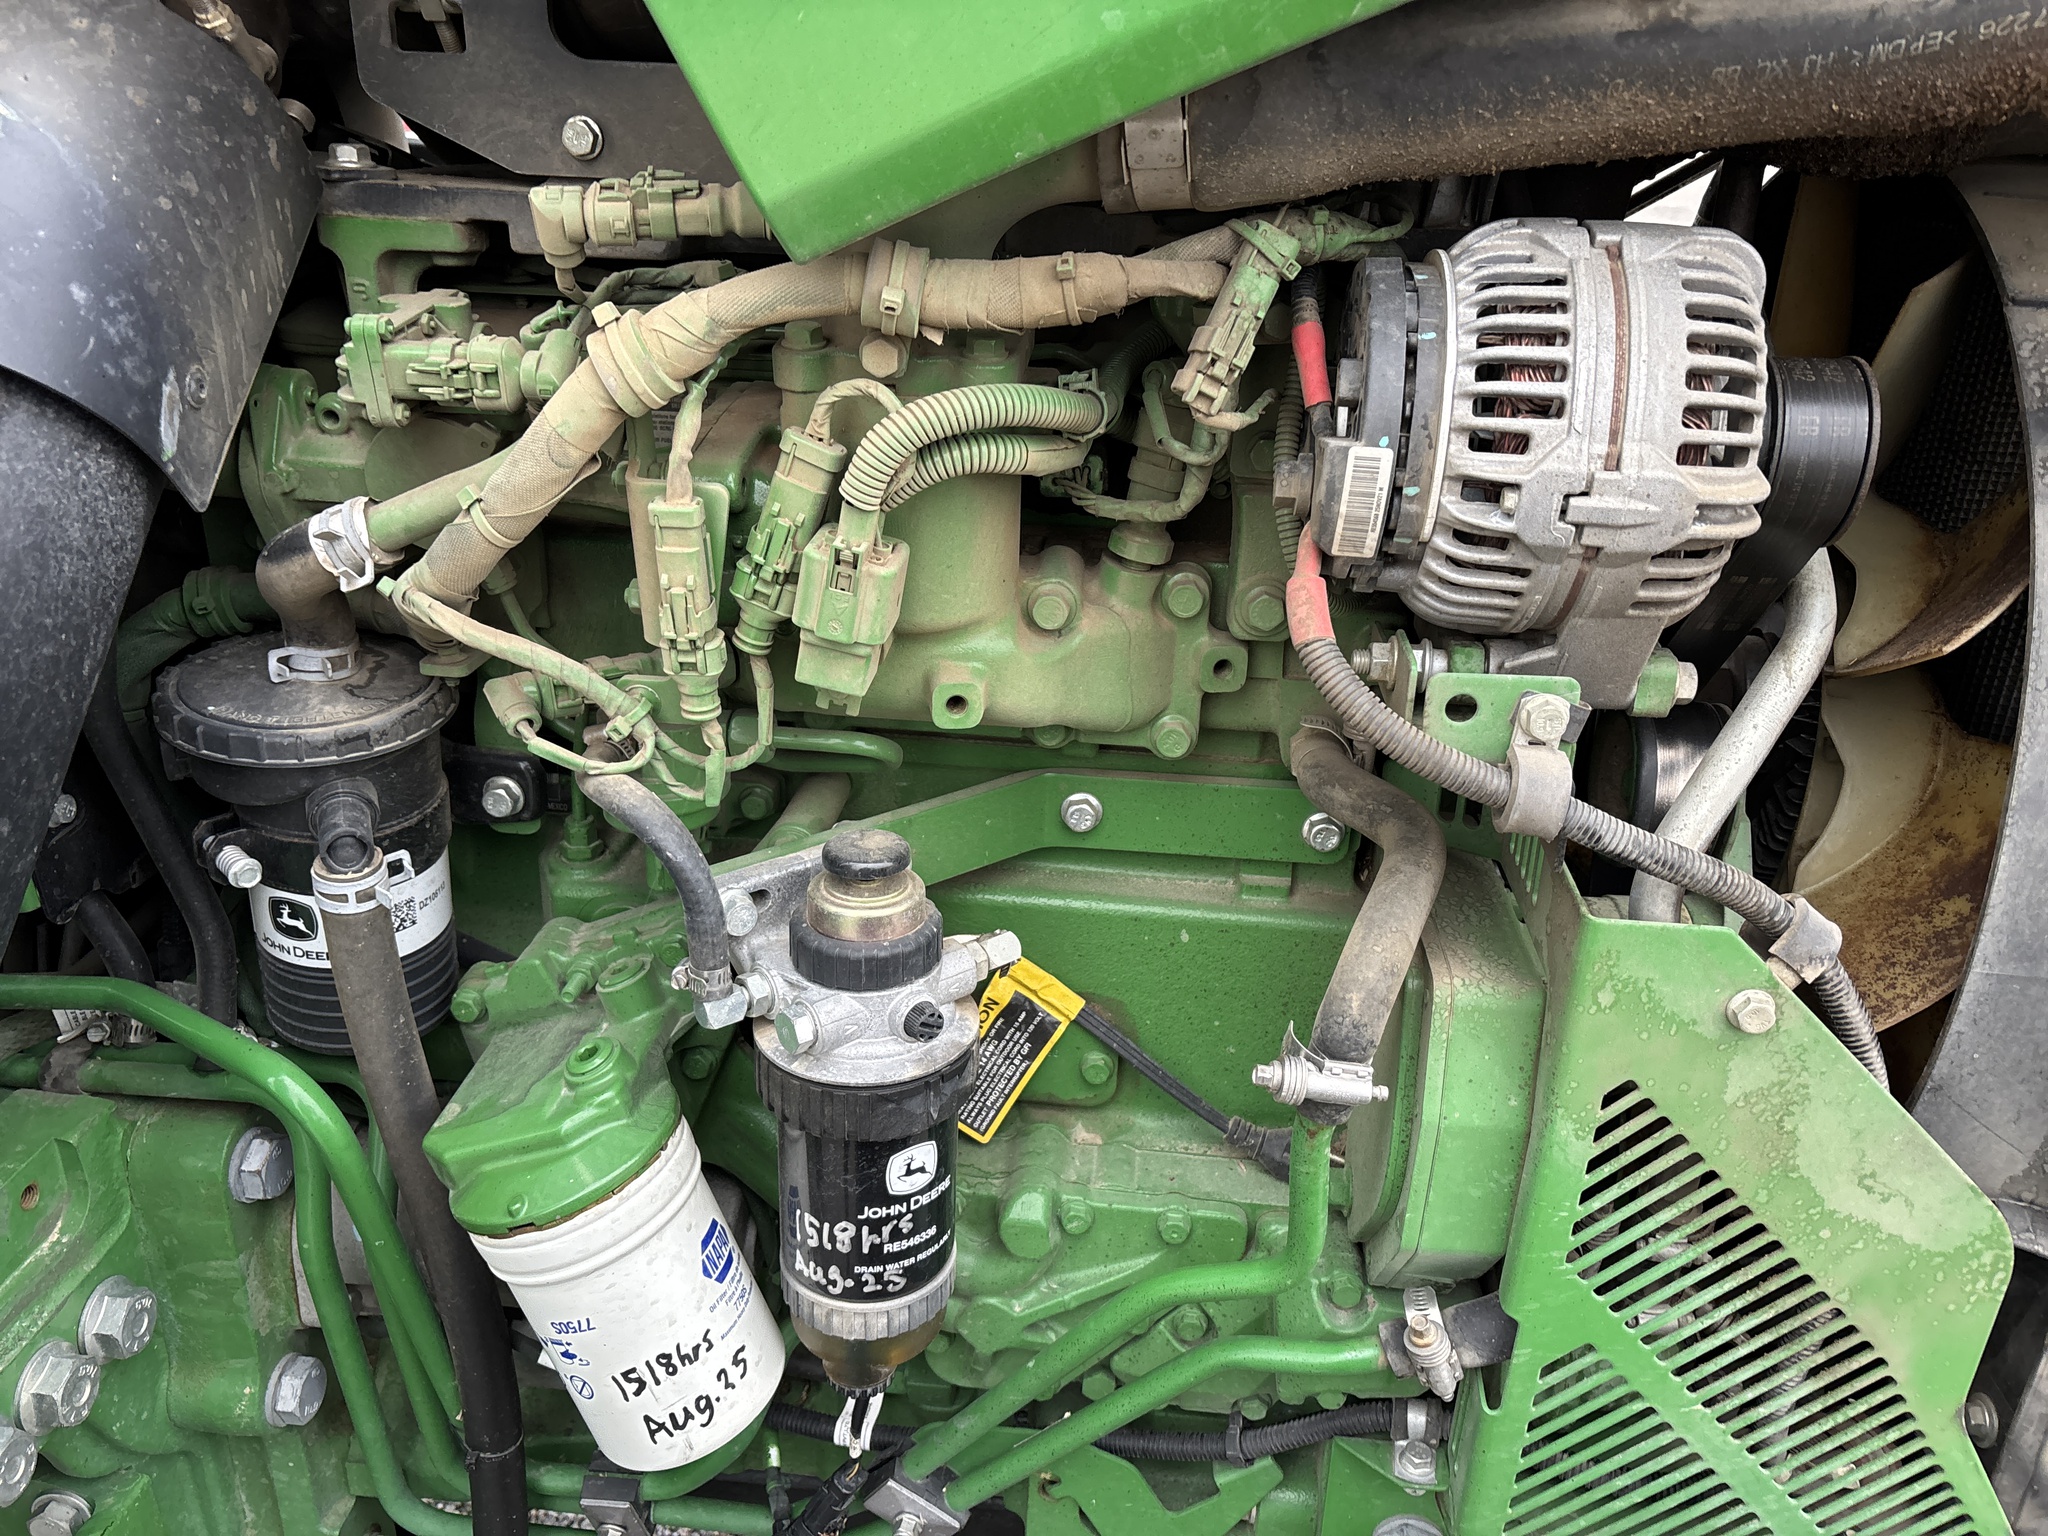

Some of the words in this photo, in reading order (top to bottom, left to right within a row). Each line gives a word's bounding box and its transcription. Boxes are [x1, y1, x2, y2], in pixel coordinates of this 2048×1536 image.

[262, 932, 291, 955] JOHN
[293, 946, 330, 961] DEE
[966, 1102, 982, 1123] ALWAYS
[980, 1088, 992, 1102] PLUG
[990, 1059, 1011, 1088] ELECTRICAL
[1009, 1043, 1021, 1058] CORD
[1019, 1032, 1029, 1044] INTO
[1032, 1011, 1044, 1024] VOLT
[976, 1055, 997, 1085] ELECTRICAL
[994, 1039, 1006, 1055] CORD
[1004, 1027, 1015, 1039] WITH
[978, 1056, 987, 1066] 14
[984, 1039, 998, 1057] AWG
[960, 1100, 975, 1119] RATING
[973, 1076, 991, 1100] SUITABLE
[989, 1065, 998, 1076] FOR
[996, 1041, 1014, 1065] OUTDOOR
[973, 1107, 988, 1128] OUTLET
[986, 1065, 1015, 1106] PROTECTED
[1013, 1054, 1022, 1065] BY
[1020, 1042, 1031, 1055] GFI
[993, 1093, 1005, 1109] FAULT
[857, 1201, 907, 1220] JOHN
[910, 1174, 951, 1211] DEERE
[883, 1225, 937, 1254] RE546336
[854, 1264, 884, 1274] DRAIN
[885, 1257, 916, 1272] WATER
[861, 1269, 907, 1293] 25
[709, 1305, 718, 1313] Oil
[716, 1290, 728, 1305] Filter
[550, 1318, 596, 1335] 7750S
